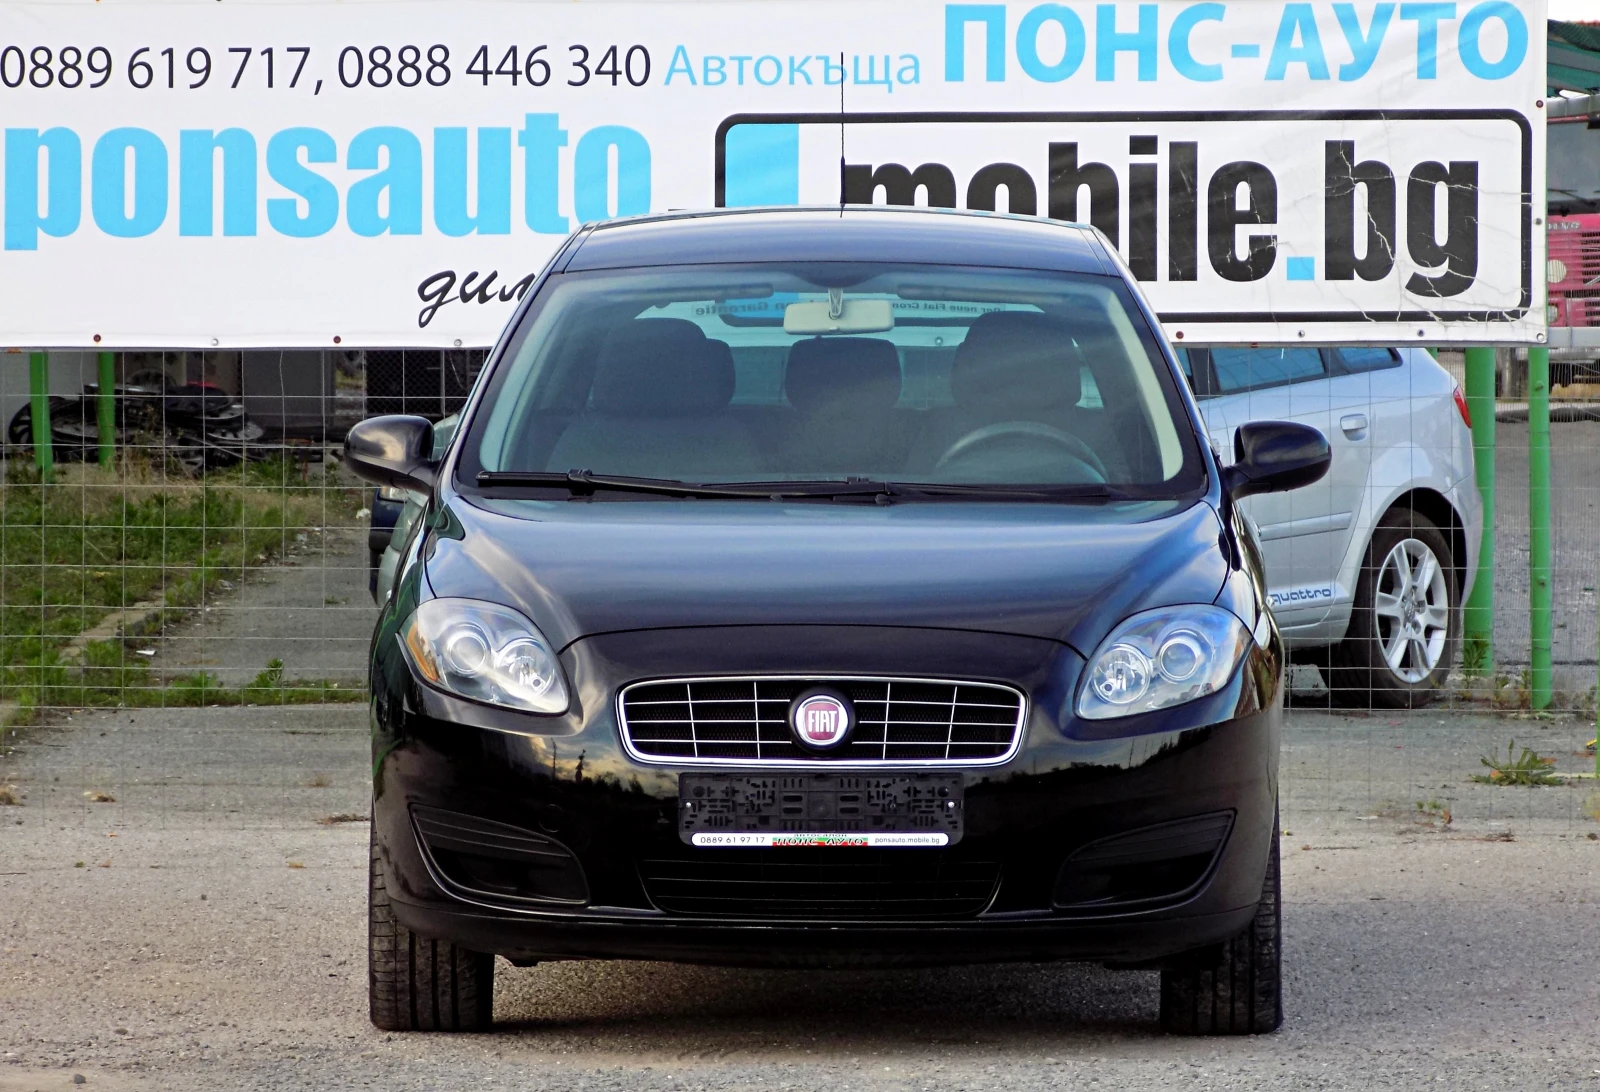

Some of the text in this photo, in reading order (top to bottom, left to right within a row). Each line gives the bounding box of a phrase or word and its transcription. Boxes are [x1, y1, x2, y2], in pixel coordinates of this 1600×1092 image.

[0, 1, 1529, 96] 0889 619 717, 0888 446 340 Автокъща ПОНС-АУТО
[3, 112, 652, 251] ponsauto
[1270, 588, 1332, 605] quattro
[807, 709, 838, 733] FIAT
[700, 836, 765, 844] 0889 61 97 17
[874, 836, 941, 845] ponsauto.mobile.bg
